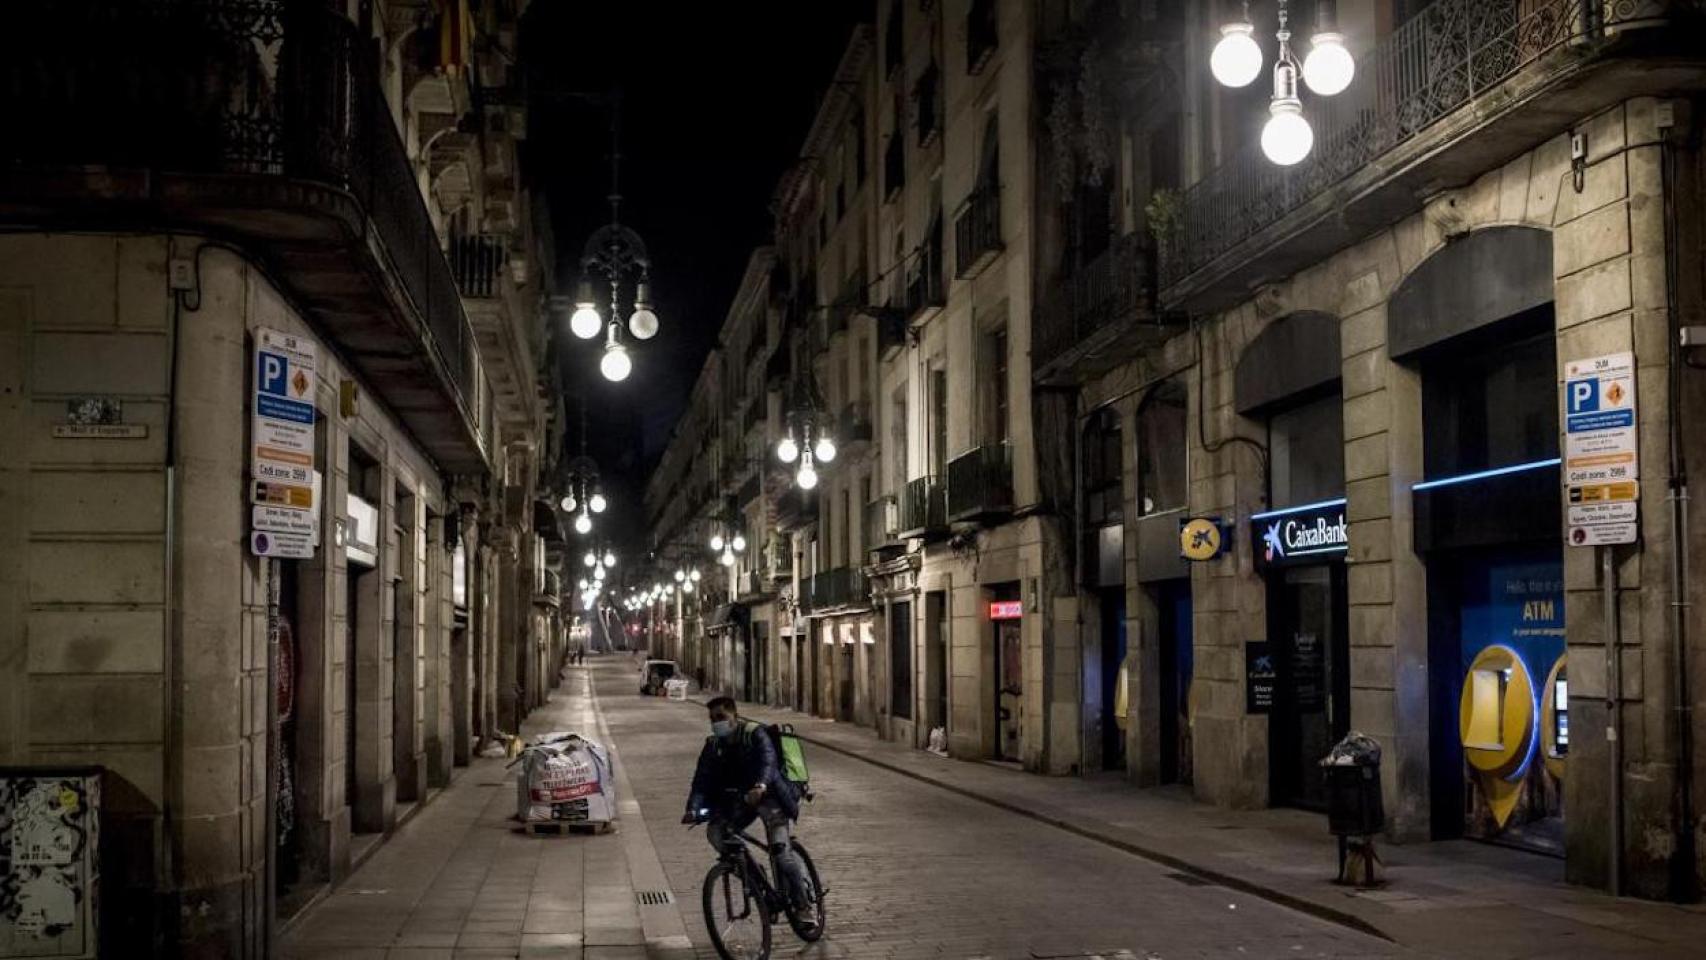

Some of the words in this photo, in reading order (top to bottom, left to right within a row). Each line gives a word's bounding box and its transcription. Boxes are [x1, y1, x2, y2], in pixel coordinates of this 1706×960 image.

[264, 355, 281, 390] P
[1574, 382, 1592, 411] P
[1286, 514, 1347, 548] CaixaBank
[1523, 601, 1553, 621] ATM
